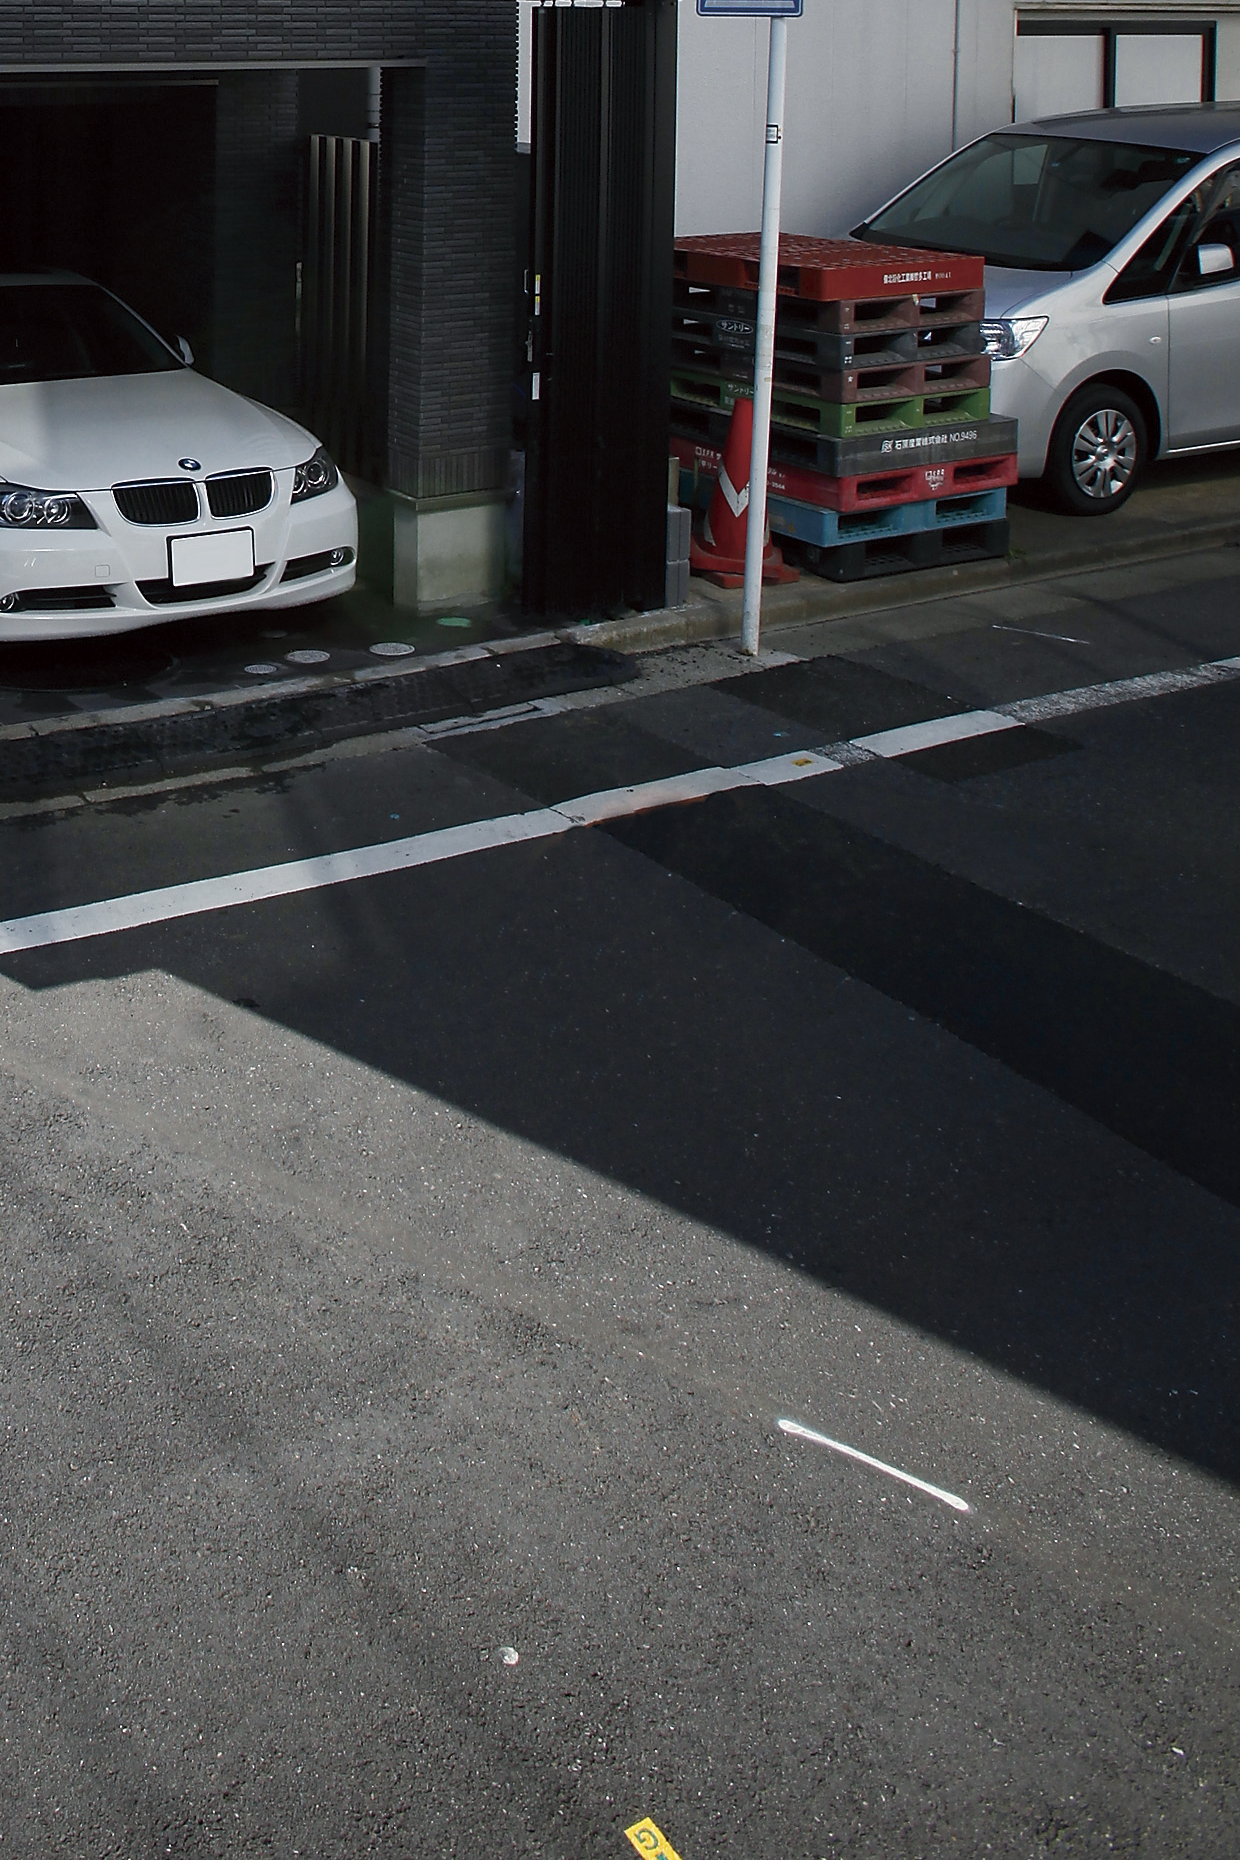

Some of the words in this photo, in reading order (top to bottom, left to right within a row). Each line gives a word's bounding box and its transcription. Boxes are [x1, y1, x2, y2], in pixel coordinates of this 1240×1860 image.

[722, 322, 750, 333] サントリー
[634, 1828, 658, 1850] G
